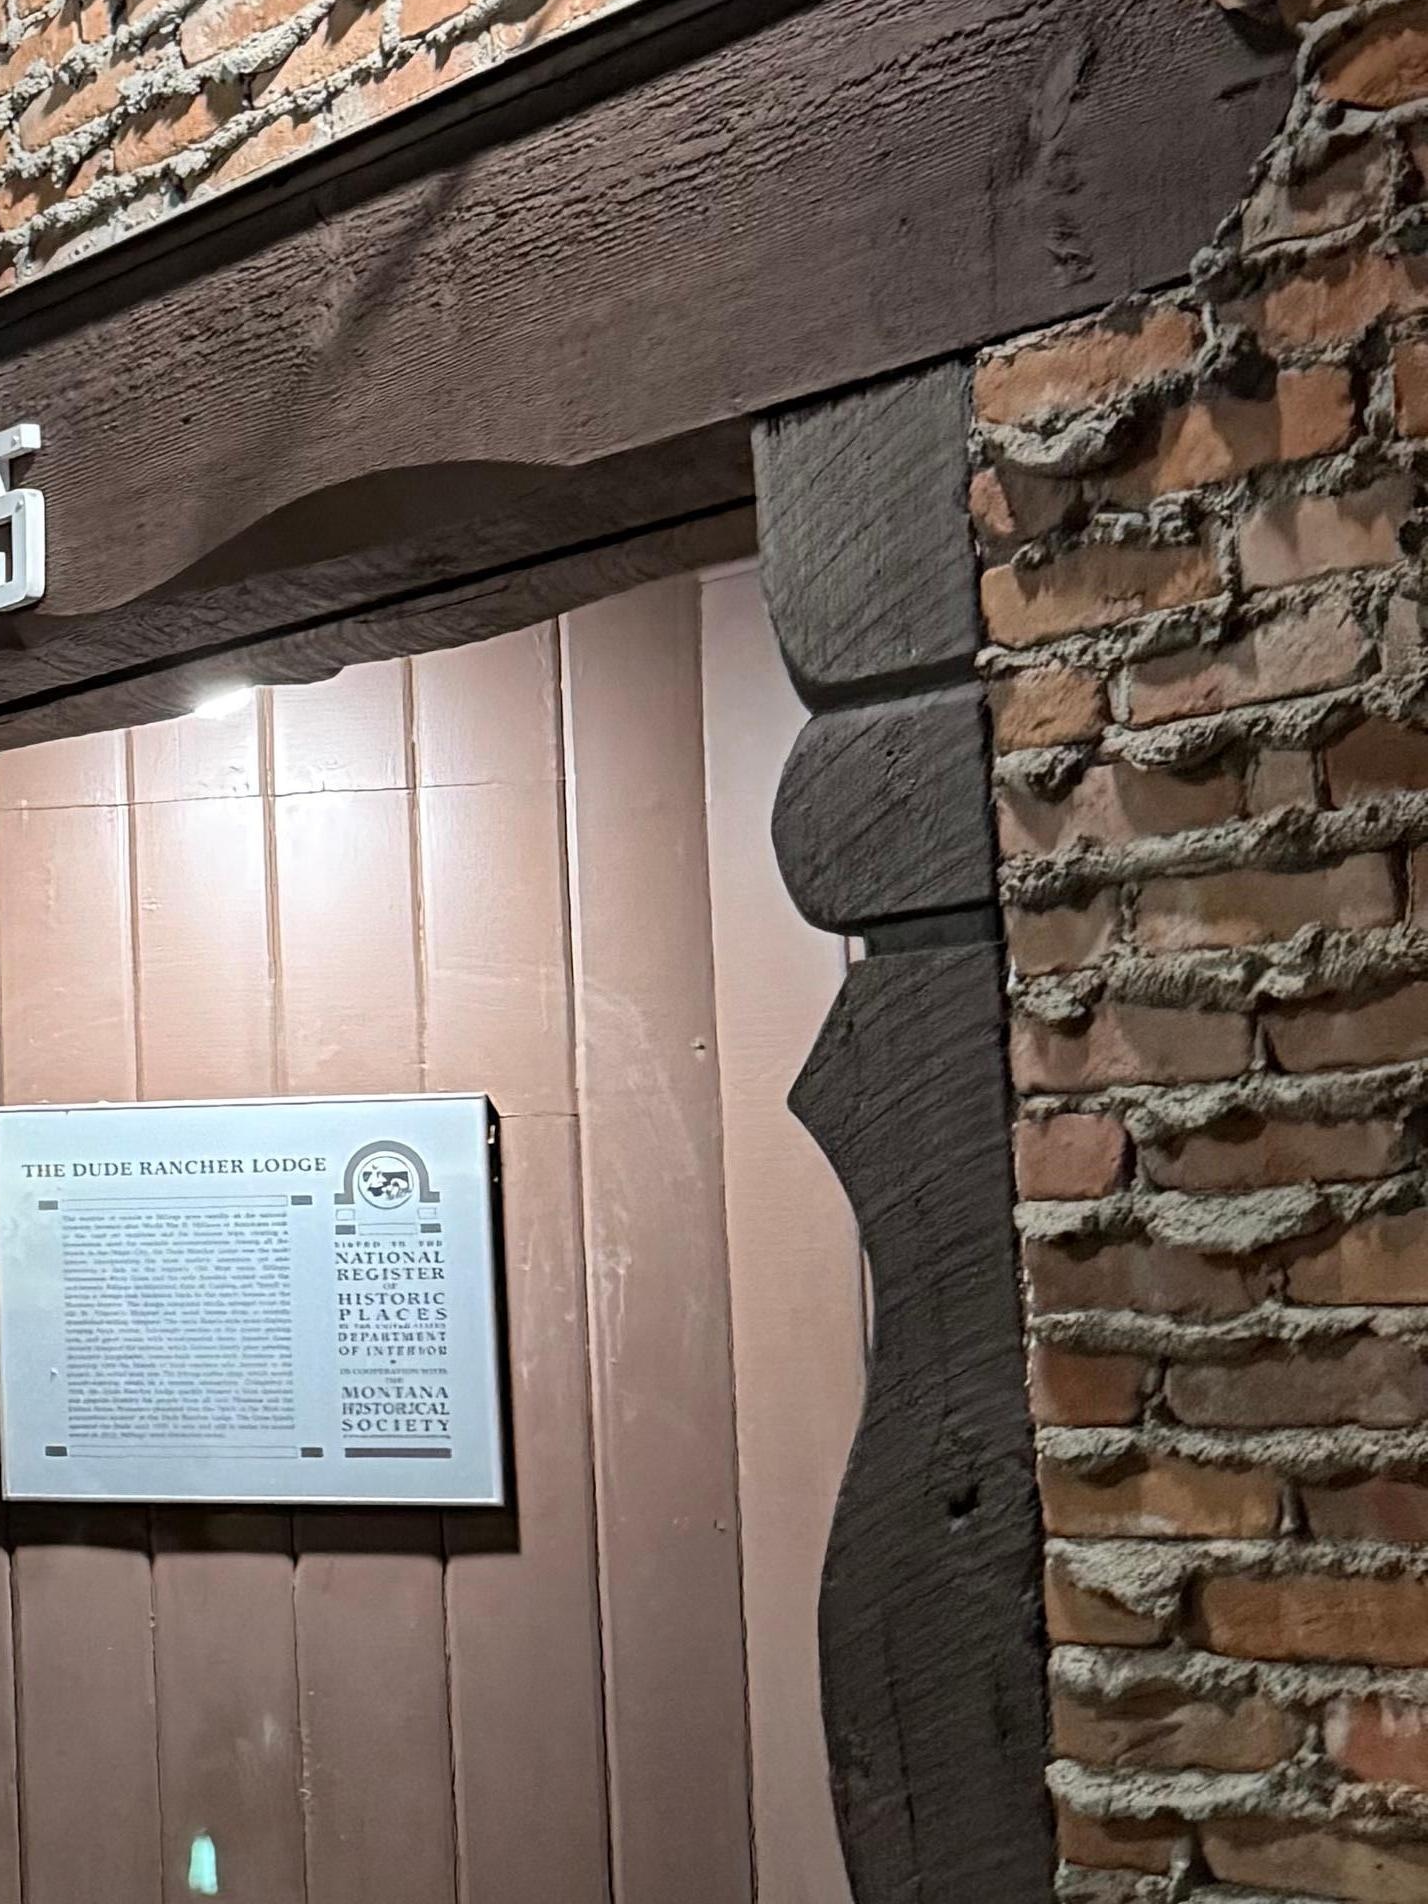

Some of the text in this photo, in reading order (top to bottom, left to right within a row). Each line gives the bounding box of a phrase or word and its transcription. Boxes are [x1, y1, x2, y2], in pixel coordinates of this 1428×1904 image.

[21, 1157, 327, 1178] THE DUDE RANCHER LODGE
[335, 1251, 445, 1264] NATIONAL
[337, 1267, 445, 1280] REGISTER
[338, 1292, 446, 1305] HISTORIC
[339, 1308, 448, 1321] PLACES
[338, 1332, 446, 1342] DEPARTMENT
[338, 1345, 447, 1356] OF INTERIOR
[342, 1386, 448, 1399] MONTANA
[342, 1402, 450, 1415] HISTORICAL
[341, 1419, 450, 1432] SOCIETY
